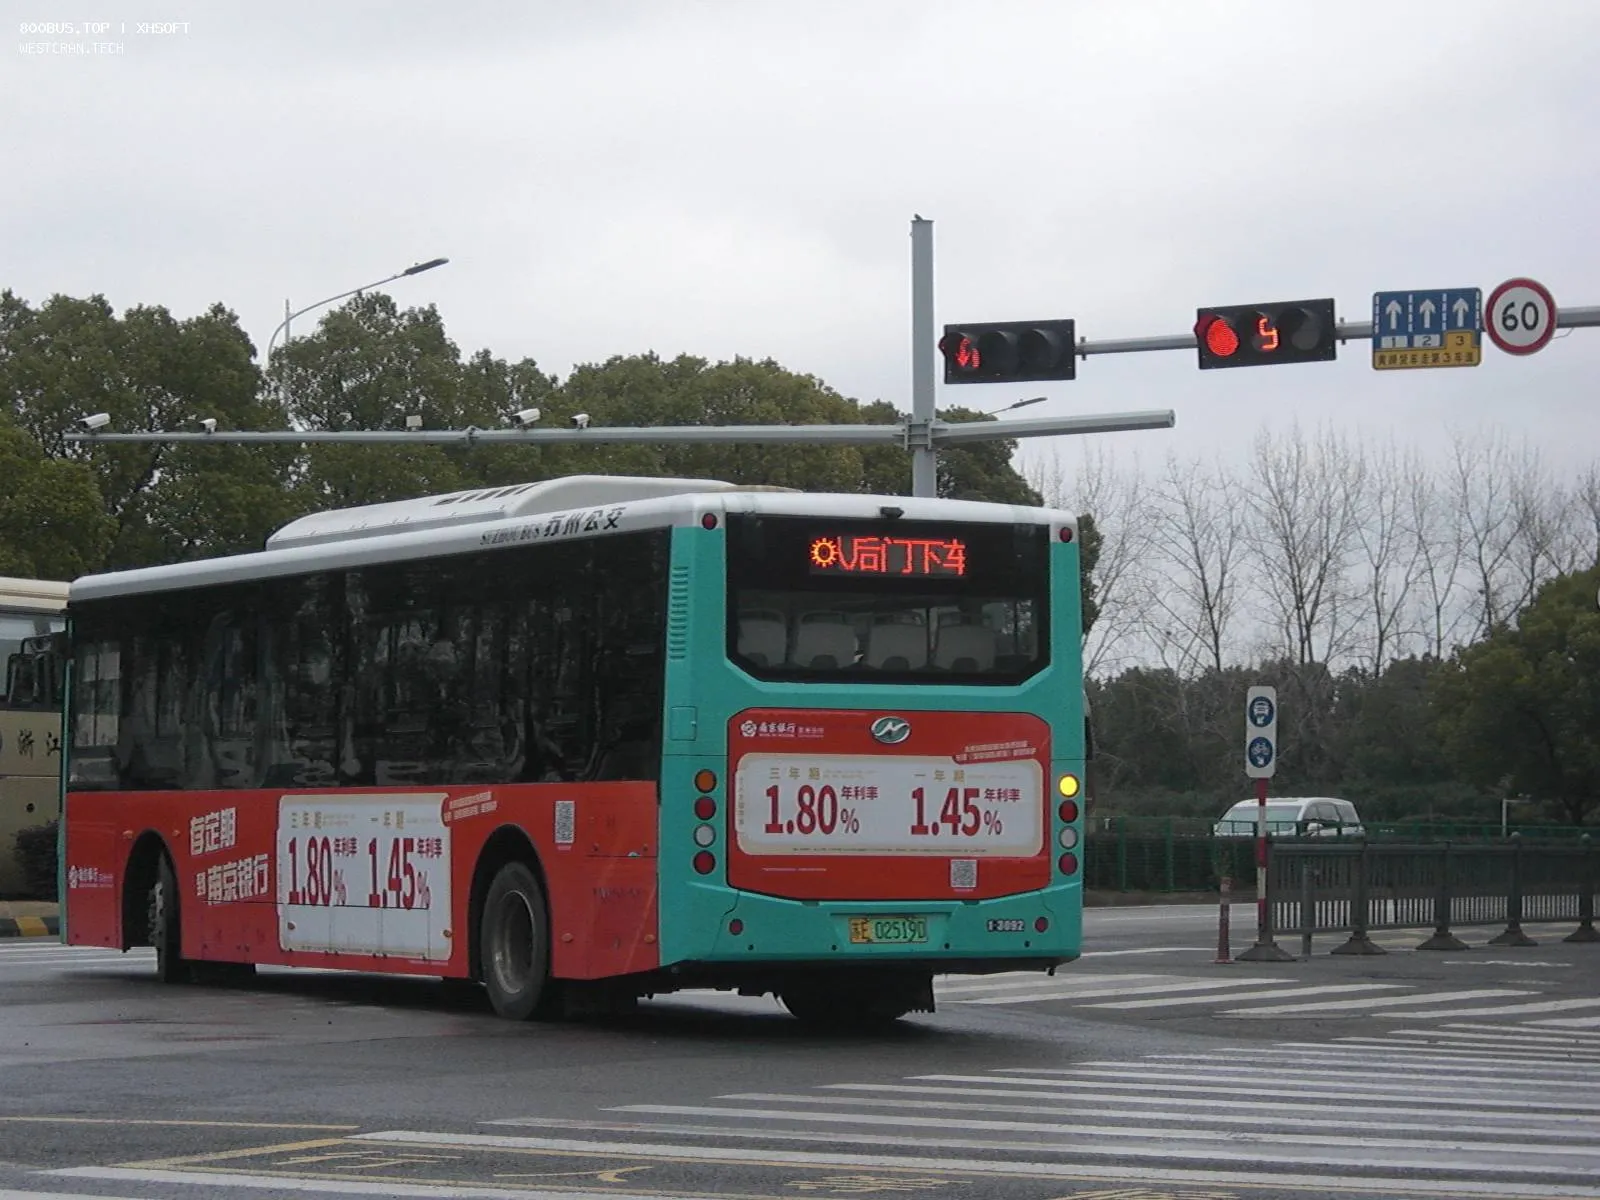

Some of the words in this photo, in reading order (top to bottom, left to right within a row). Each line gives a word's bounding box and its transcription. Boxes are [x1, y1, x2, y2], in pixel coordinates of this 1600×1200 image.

[1502, 301, 1539, 332] 60
[1421, 335, 1432, 347] 2
[1455, 334, 1465, 346] 3
[841, 785, 879, 801] 年利率
[983, 787, 1021, 803] 年利率
